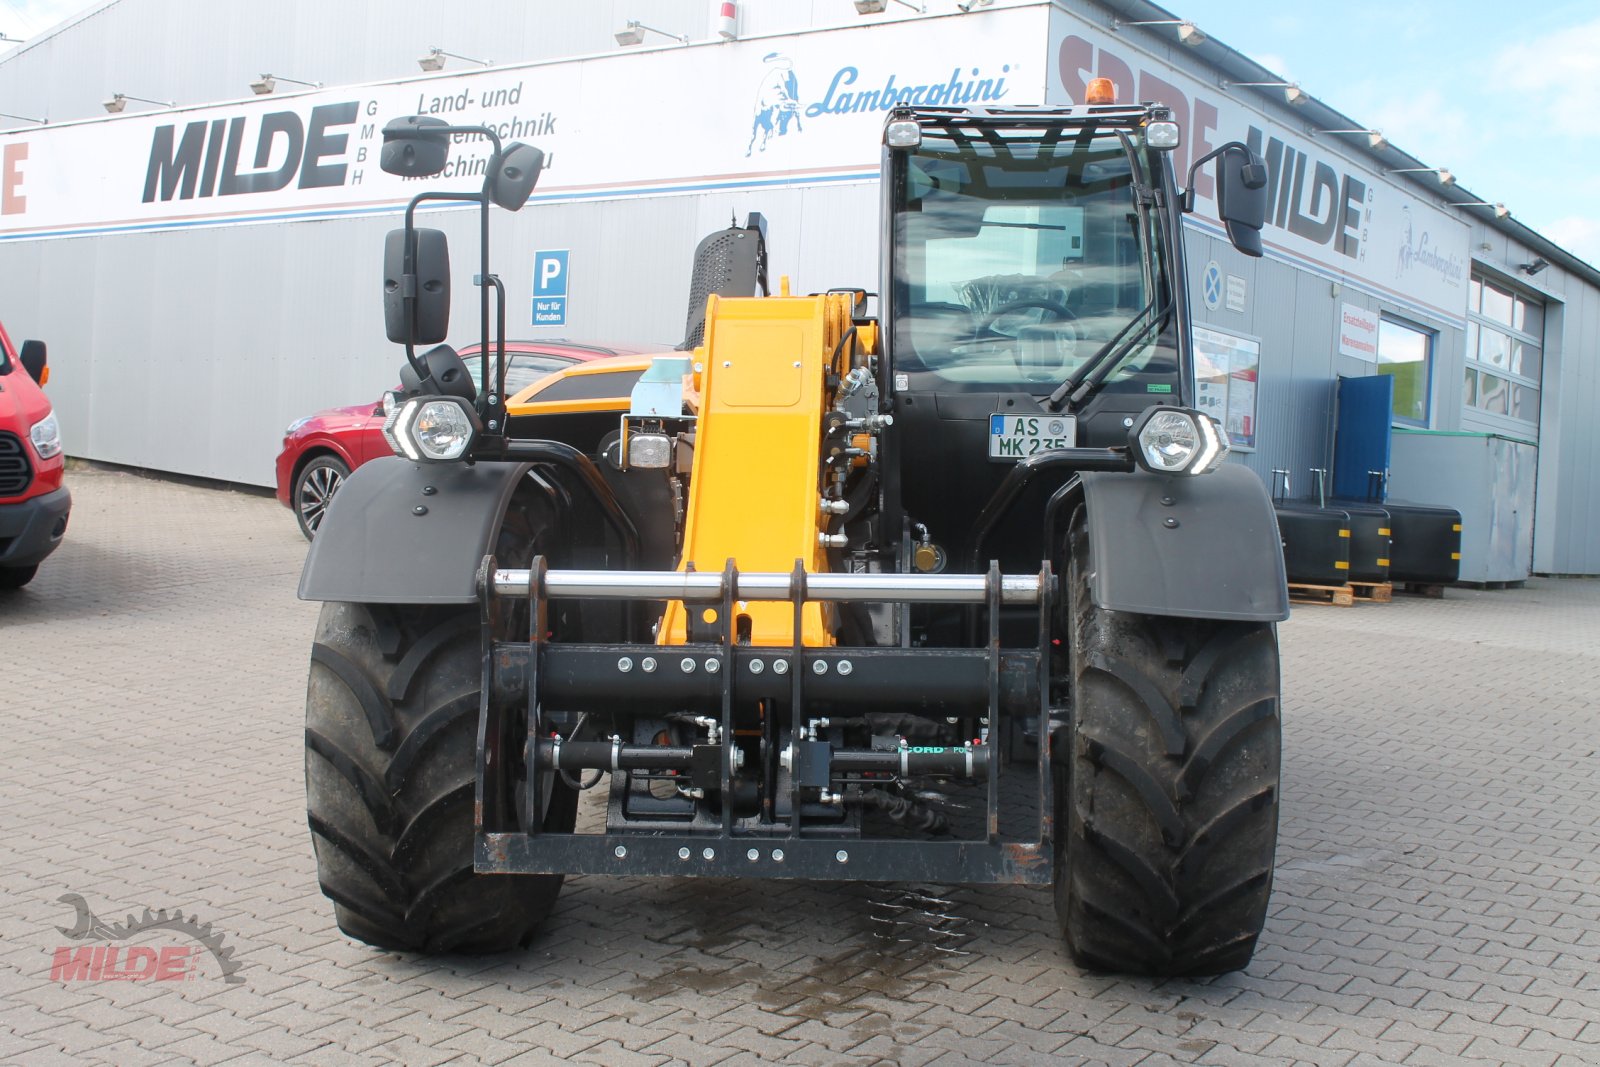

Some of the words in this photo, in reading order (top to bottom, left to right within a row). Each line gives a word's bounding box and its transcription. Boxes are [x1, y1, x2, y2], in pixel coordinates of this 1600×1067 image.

[416, 87, 475, 116] Land-
[481, 81, 523, 108] und
[805, 63, 1011, 118] Lamborghini
[141, 101, 360, 204] MILDE
[541, 258, 561, 289] P
[536, 312, 561, 321] Kunden
[537, 302, 550, 311] Nur
[551, 301, 561, 311] für
[1014, 418, 1039, 436] AS
[999, 438, 1024, 456] MK
[1029, 438, 1066, 456] 235
